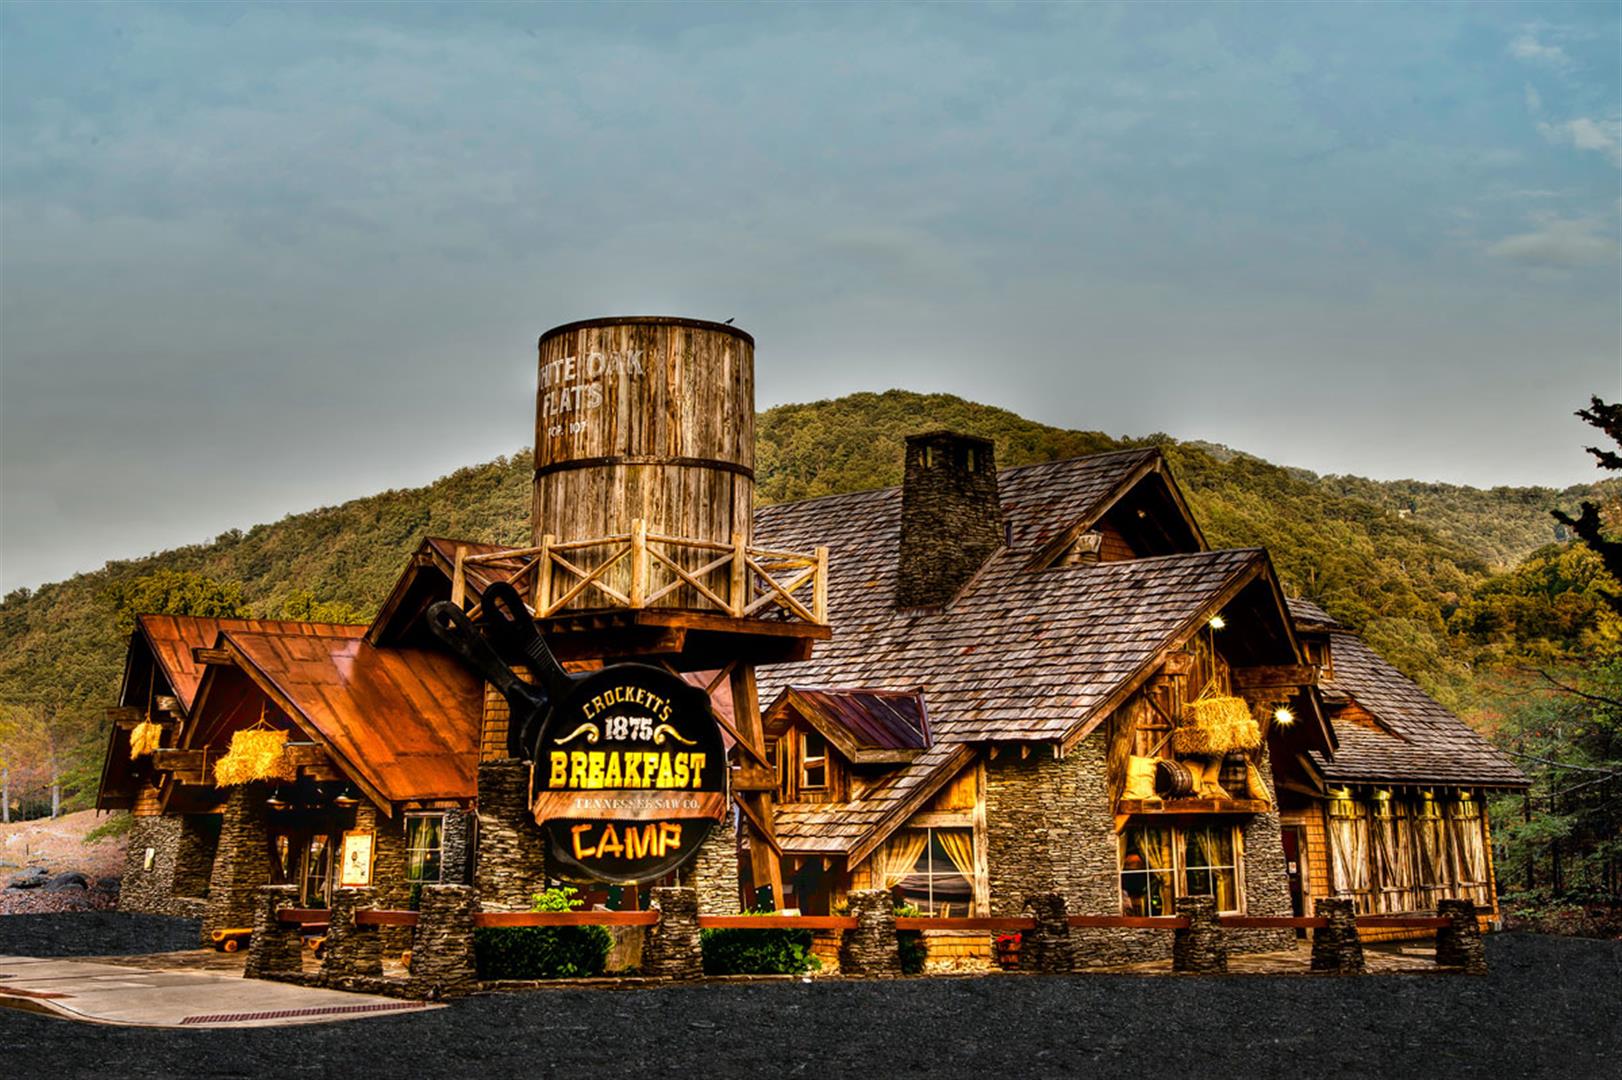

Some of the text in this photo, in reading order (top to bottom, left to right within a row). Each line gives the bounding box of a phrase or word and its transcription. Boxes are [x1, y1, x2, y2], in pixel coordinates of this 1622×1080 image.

[586, 350, 645, 378] OAK
[543, 382, 603, 418] FLATS
[582, 686, 673, 722] CROCKETT'S
[604, 716, 653, 741] 1875
[549, 751, 706, 789] BREAKFAST
[655, 798, 680, 809] SAW
[683, 799, 700, 809] CO.
[571, 822, 682, 860] CAMP
